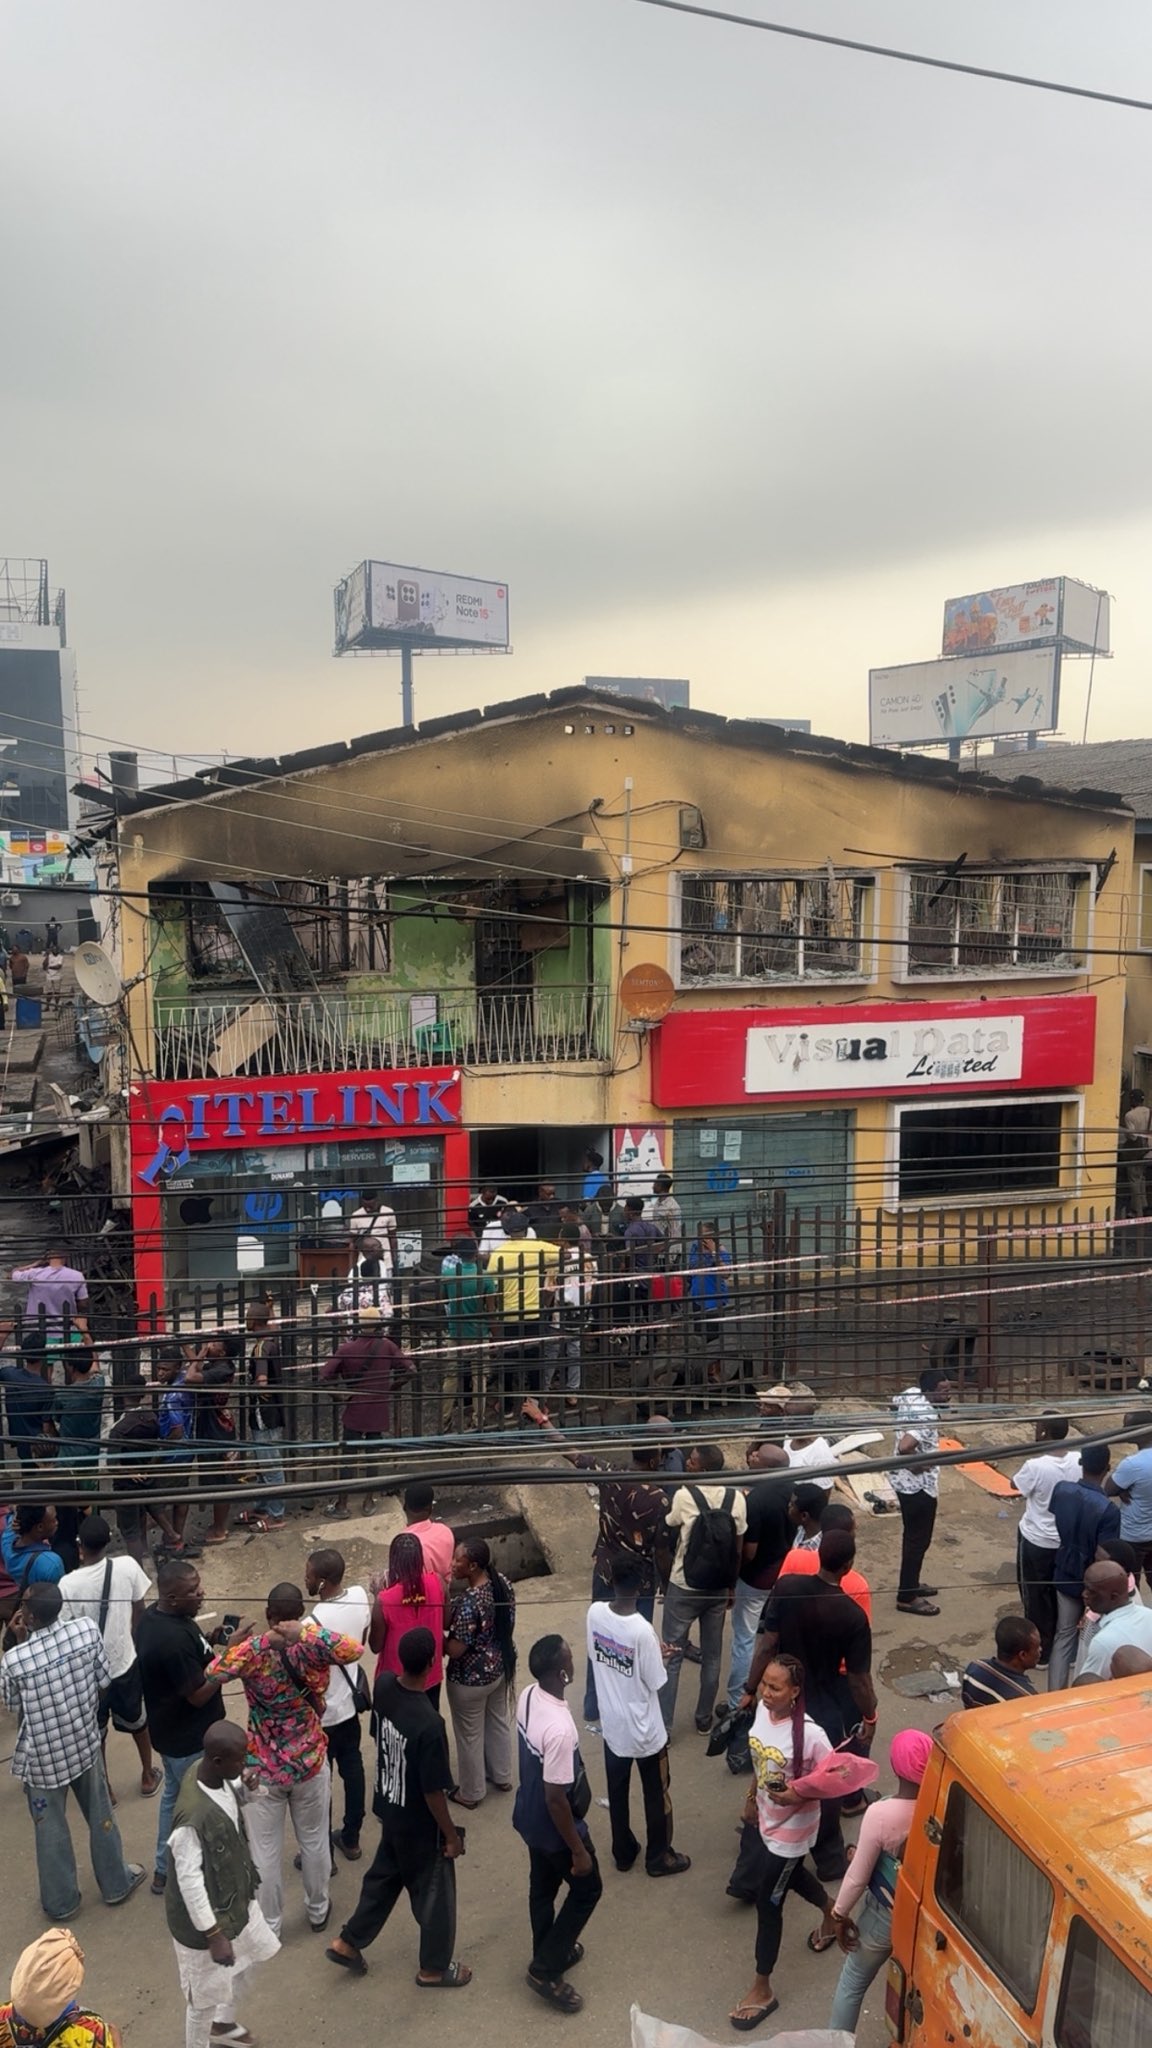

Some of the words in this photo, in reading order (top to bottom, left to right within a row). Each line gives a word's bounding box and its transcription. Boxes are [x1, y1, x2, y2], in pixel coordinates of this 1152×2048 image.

[456, 594, 482, 606] REDMI
[456, 605, 479, 618] Note
[480, 608, 489, 620] 15
[880, 696, 910, 707] CAMON
[764, 1029, 901, 1063] Visual
[912, 1027, 1010, 1057] Data
[906, 1055, 998, 1079] Lited
[341, 1151, 377, 1162] SERVERS
